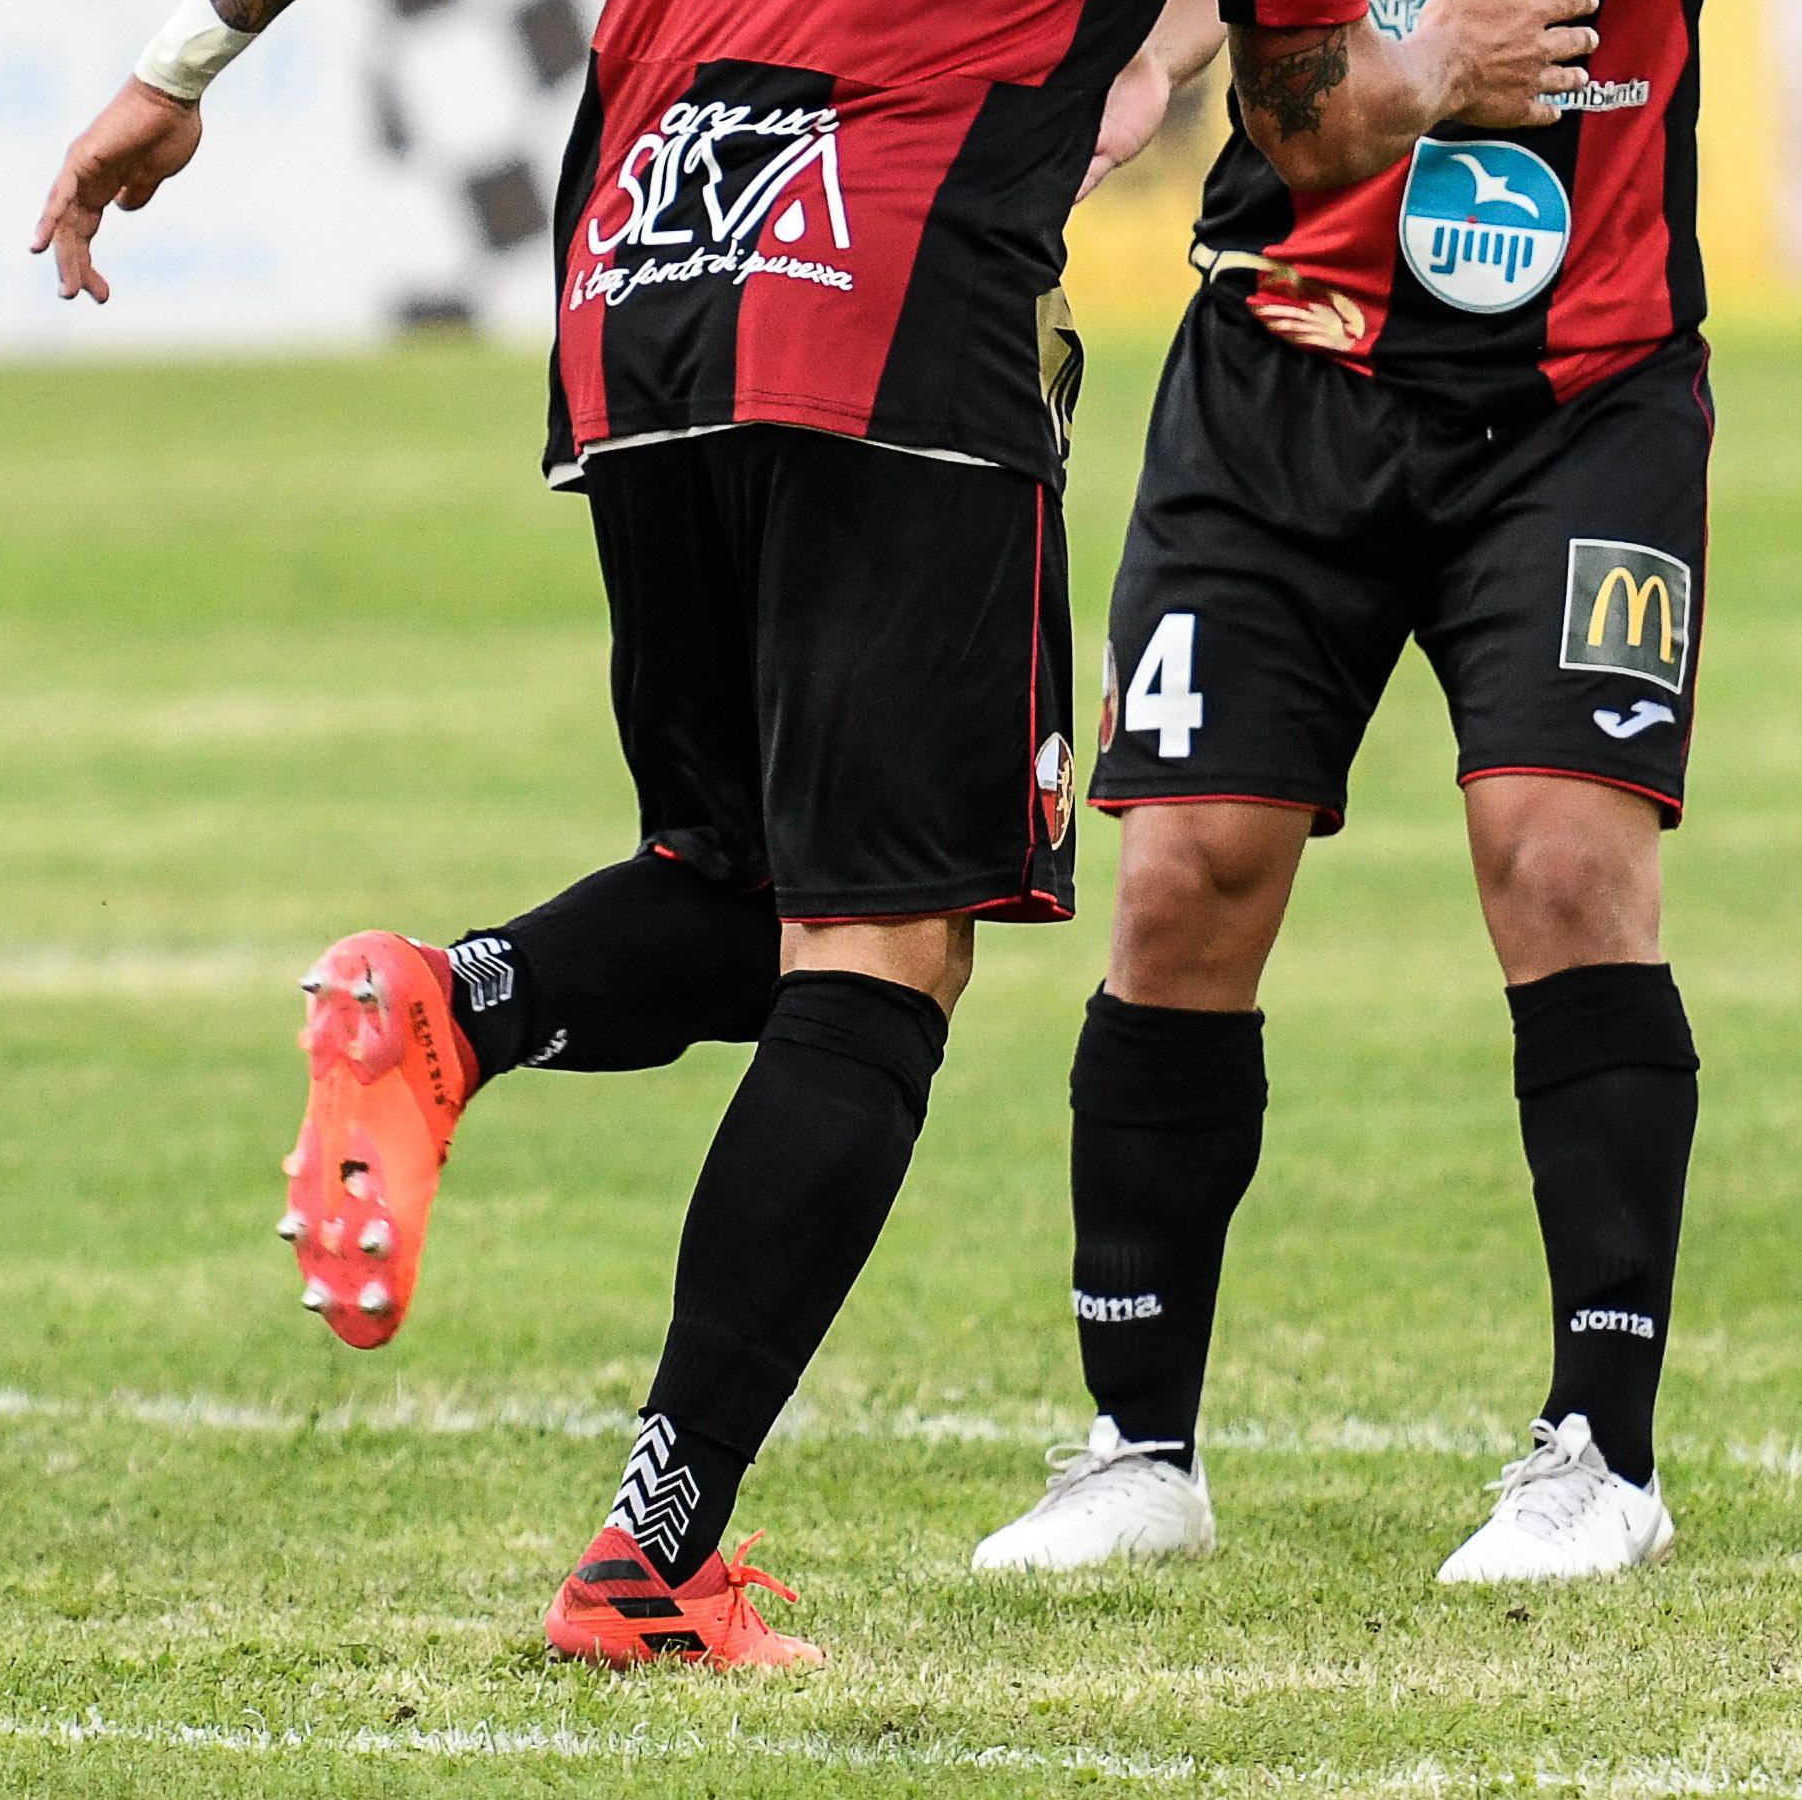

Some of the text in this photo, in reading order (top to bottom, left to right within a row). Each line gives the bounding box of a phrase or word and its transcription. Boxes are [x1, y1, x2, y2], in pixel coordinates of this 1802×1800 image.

[588, 133, 851, 254] SILVA
[1125, 613, 1202, 758] 4
[1570, 1309, 1654, 1339] Joma
